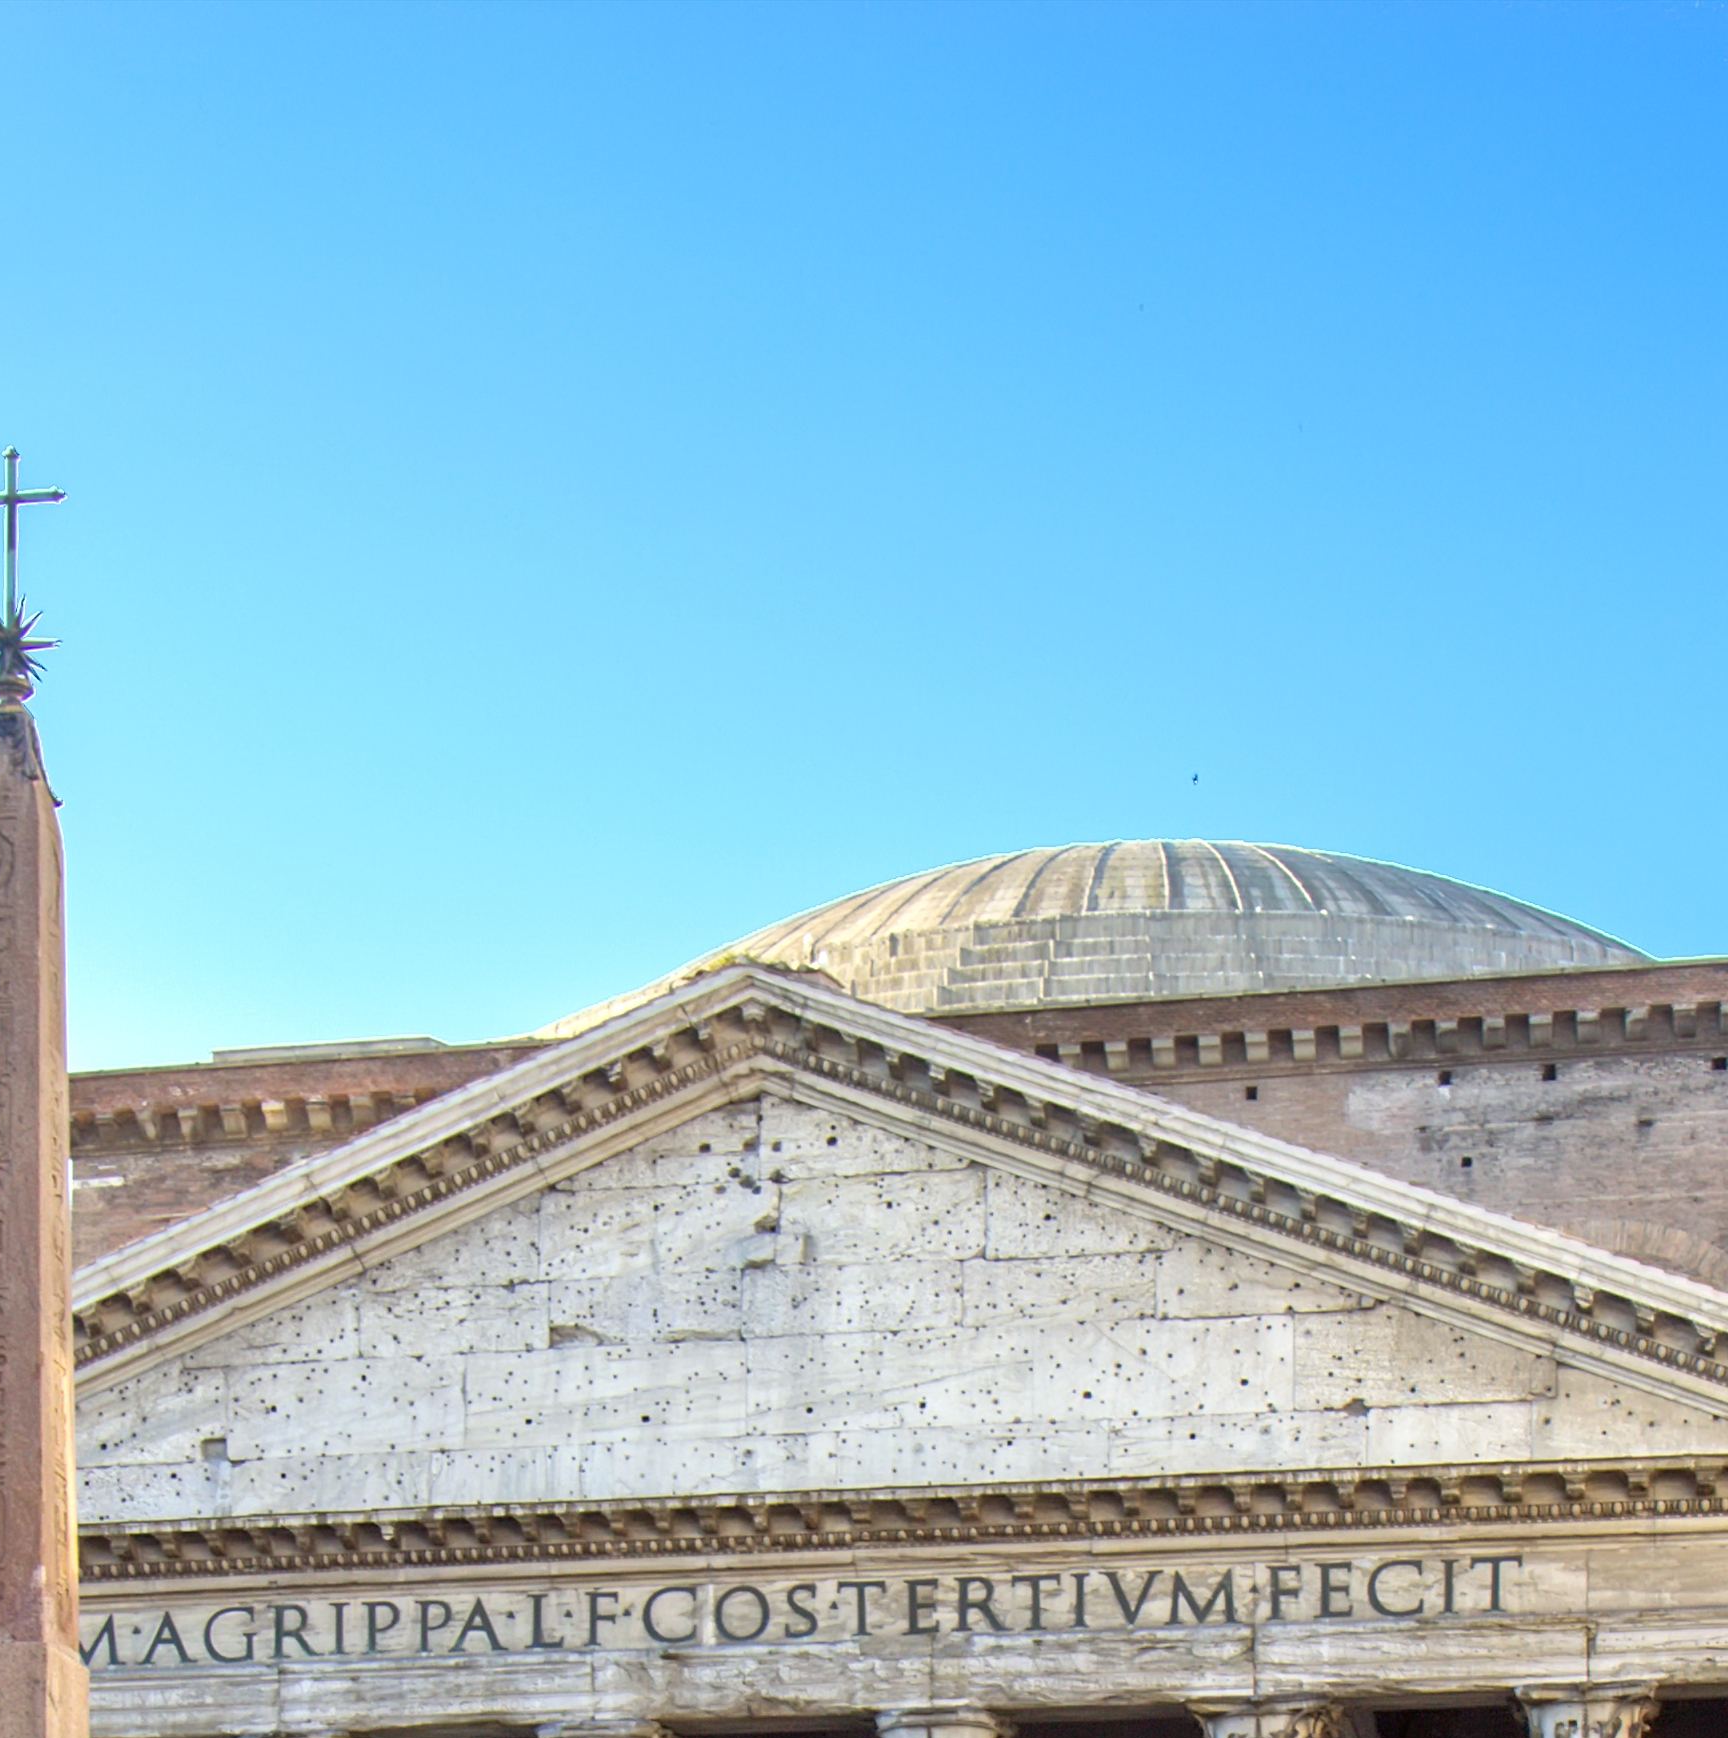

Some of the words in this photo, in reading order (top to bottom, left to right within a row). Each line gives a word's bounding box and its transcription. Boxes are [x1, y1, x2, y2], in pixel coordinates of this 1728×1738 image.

[135, 1597, 508, 1666] AGRIPPA
[642, 1584, 818, 1644] COS
[838, 1569, 1241, 1636] TERTIVM
[1269, 1555, 1523, 1621] FECIT
